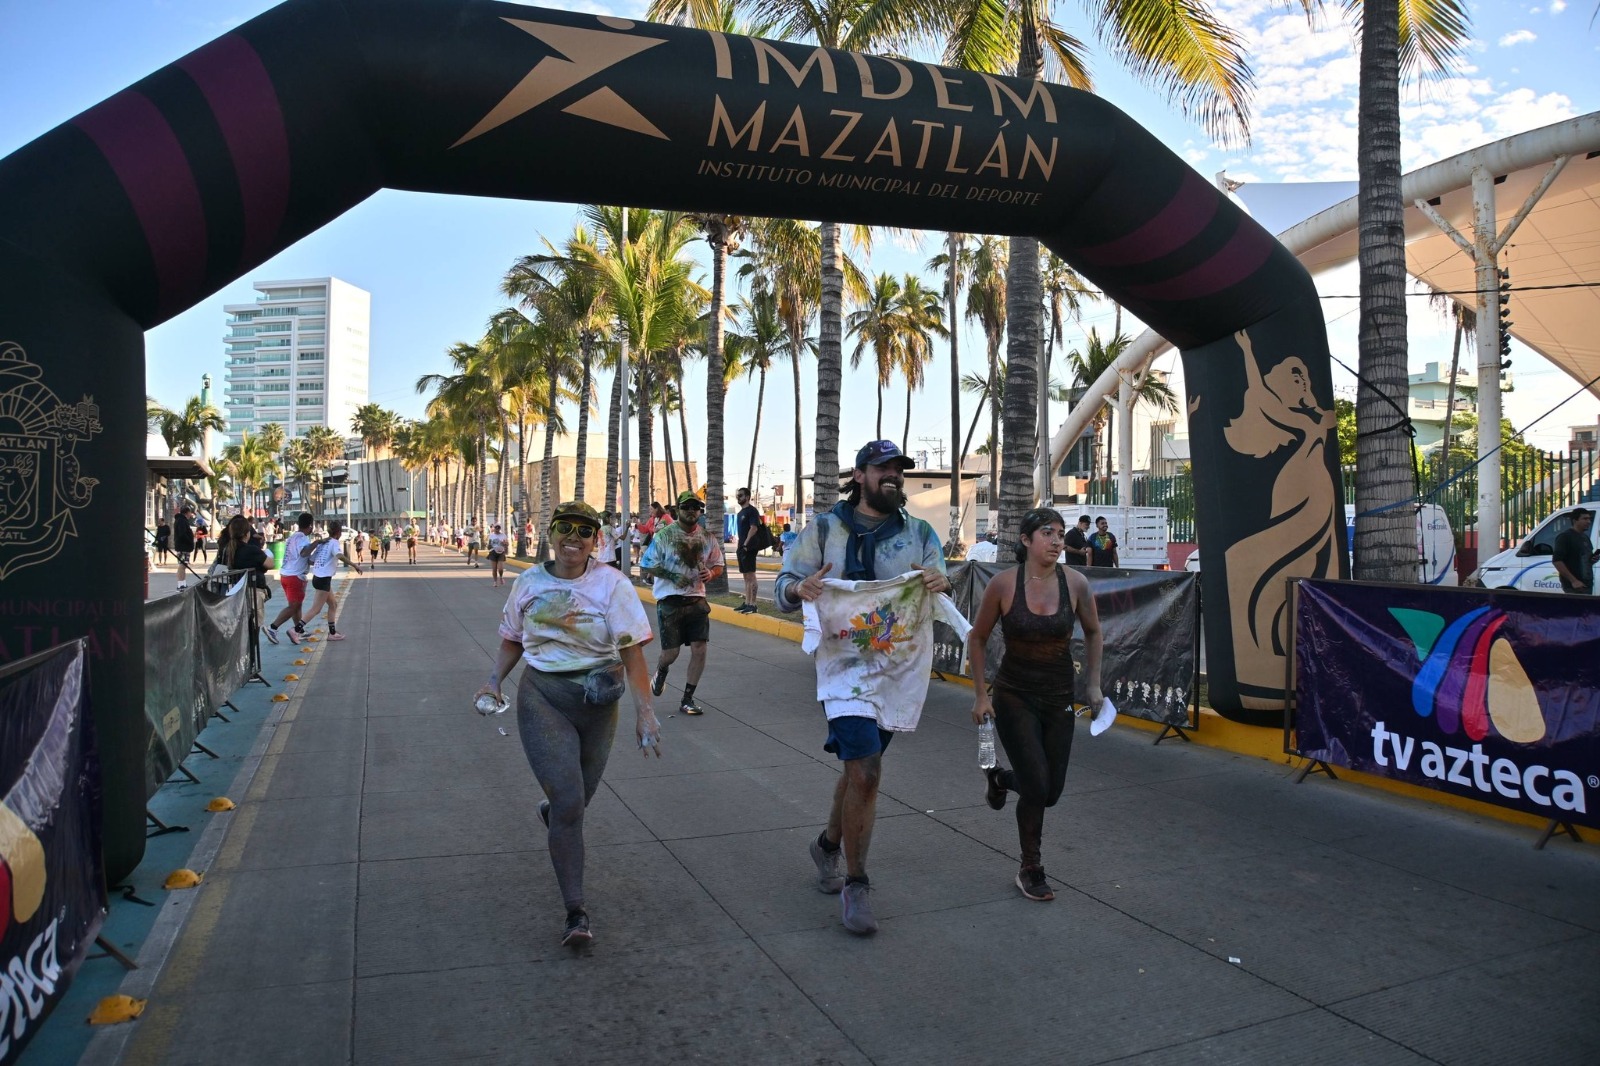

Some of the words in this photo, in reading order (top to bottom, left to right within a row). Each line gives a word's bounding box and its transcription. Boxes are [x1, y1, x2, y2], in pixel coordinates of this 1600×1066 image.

[707, 30, 1059, 124] IMDEM
[706, 93, 1059, 183] MAZATLÁN
[697, 159, 812, 185] INSTITUTO
[818, 172, 921, 196] MUNICIPAL
[928, 182, 959, 199] DEL
[965, 187, 1043, 207] DEPORTE
[1533, 579, 1562, 589] Electro
[1370, 721, 1415, 771] tv
